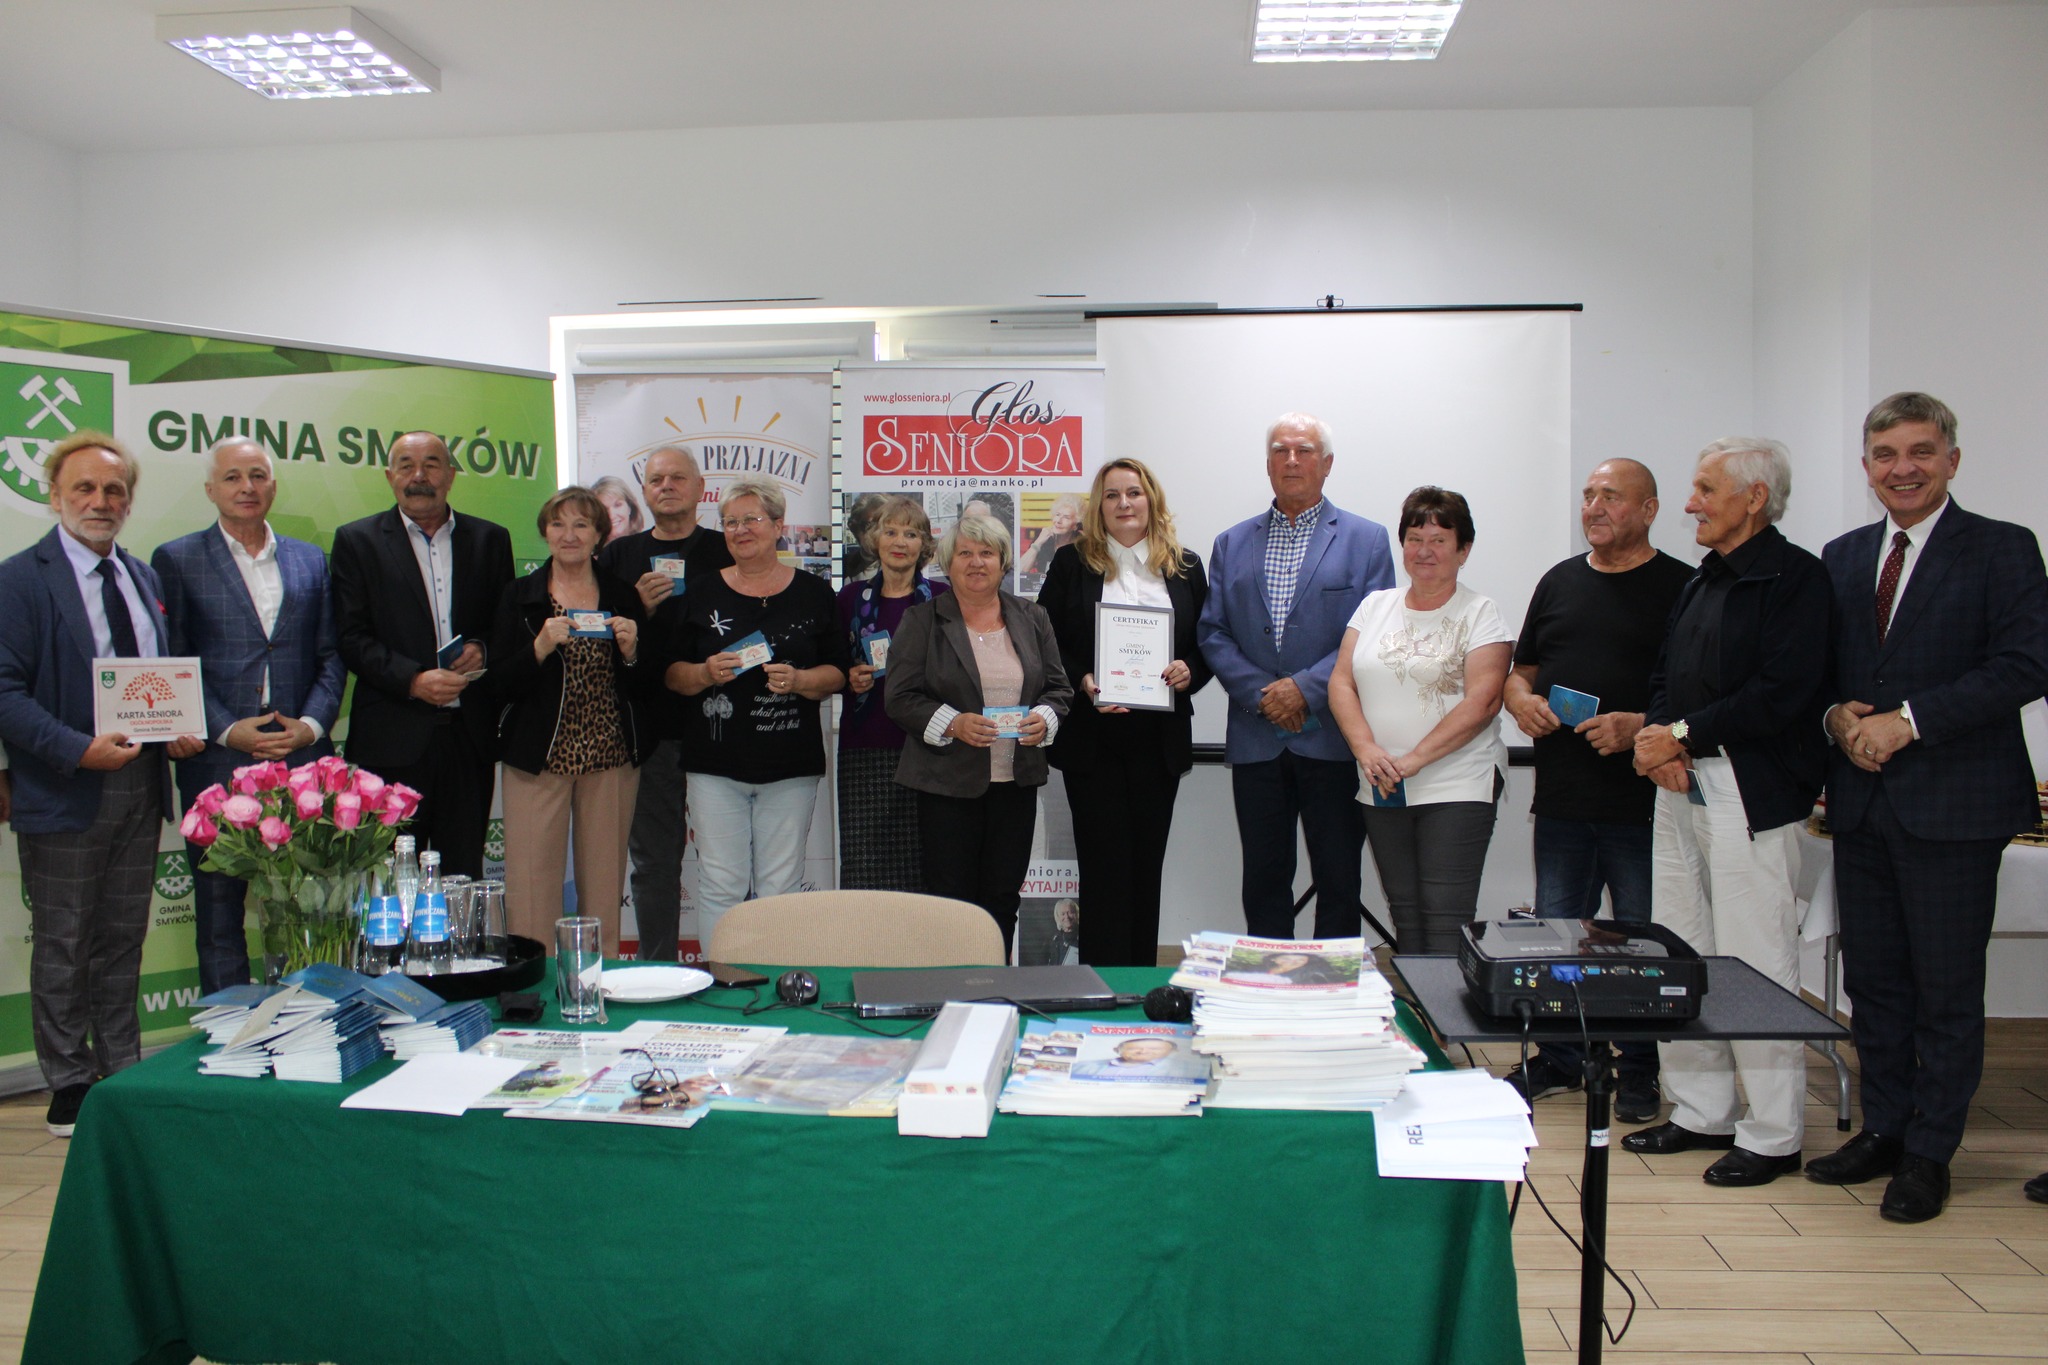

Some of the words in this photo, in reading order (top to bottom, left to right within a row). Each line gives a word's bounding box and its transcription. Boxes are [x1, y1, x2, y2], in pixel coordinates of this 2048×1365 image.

[864, 392, 951, 404] www.glosseniora.pl
[958, 380, 1063, 432] Głos
[866, 417, 1081, 474] SENIORA
[338, 426, 538, 478] SMKÓW
[703, 445, 812, 486] PRZYJAZNA
[901, 477, 1044, 488] promocja@manko.pl
[1112, 616, 1159, 626] CERTYFIKAT
[117, 711, 145, 719] KARTA
[146, 710, 184, 718] SENIORA
[485, 866, 505, 875] GMIN
[1019, 881, 1062, 893] ZYTAJ!
[159, 904, 191, 915] GMINA
[155, 913, 198, 927] SMYKÓW
